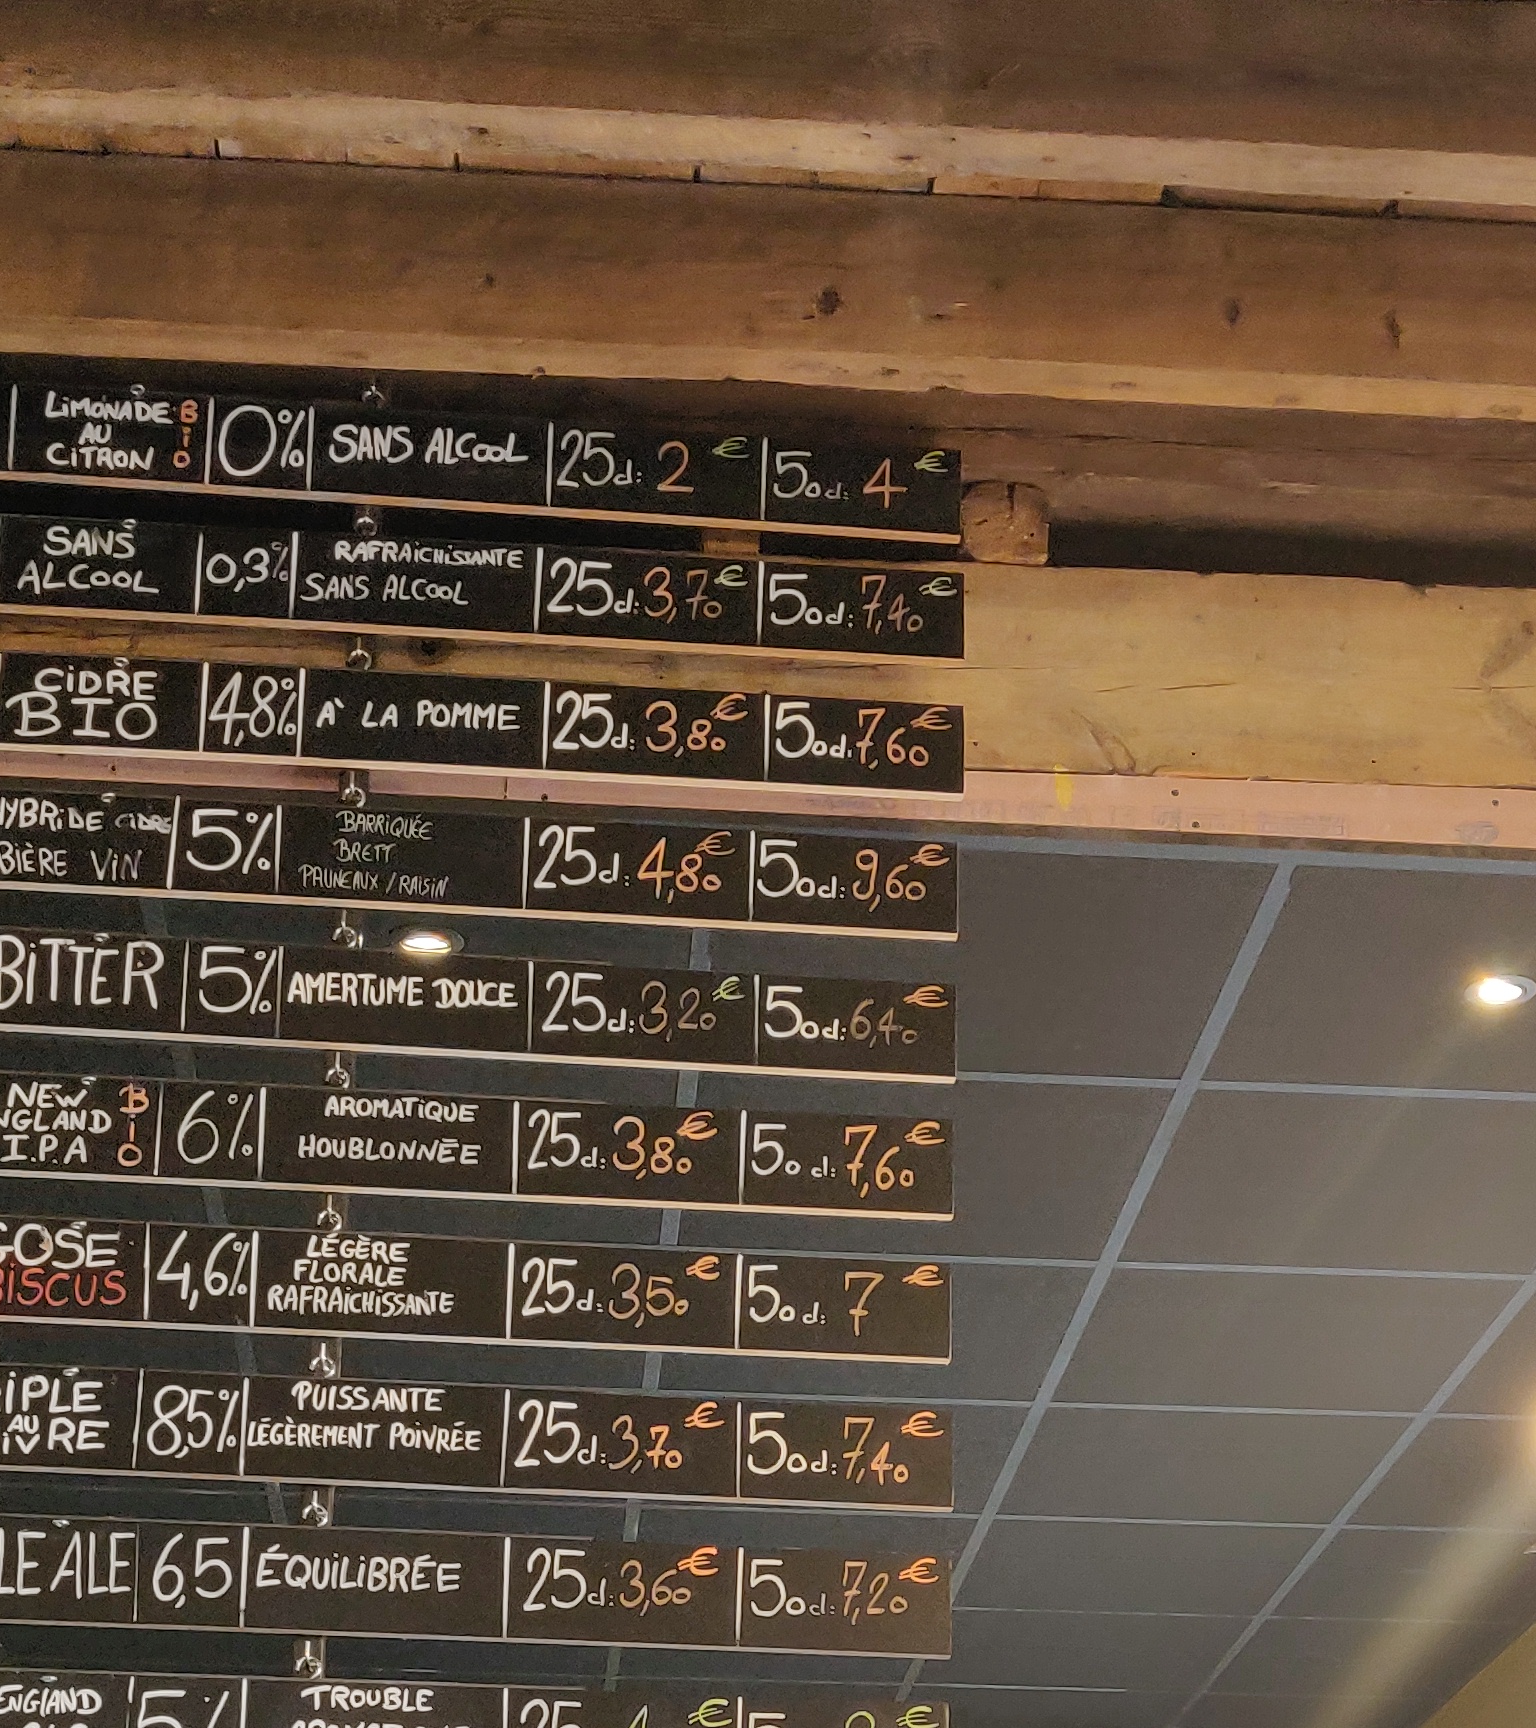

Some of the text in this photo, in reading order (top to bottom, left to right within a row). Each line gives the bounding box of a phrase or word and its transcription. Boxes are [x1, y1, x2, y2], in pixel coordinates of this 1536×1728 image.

[77, 422, 112, 446] AU
[217, 404, 306, 477] 0%
[328, 423, 414, 464] SANS
[43, 524, 136, 559] SANS
[300, 572, 370, 602] SANS
[361, 700, 398, 728] LA
[416, 699, 521, 731] POMME
[186, 808, 274, 875] 5%
[333, 838, 396, 863] BRETT
[198, 945, 275, 1015] 5%
[287, 971, 519, 1009] AMERTUME DOUCE
[177, 1090, 254, 1165] 6%
[293, 1256, 408, 1289] FLORALE
[49, 1531, 138, 1601] ALE
[300, 1684, 434, 1712] TROUBLE
